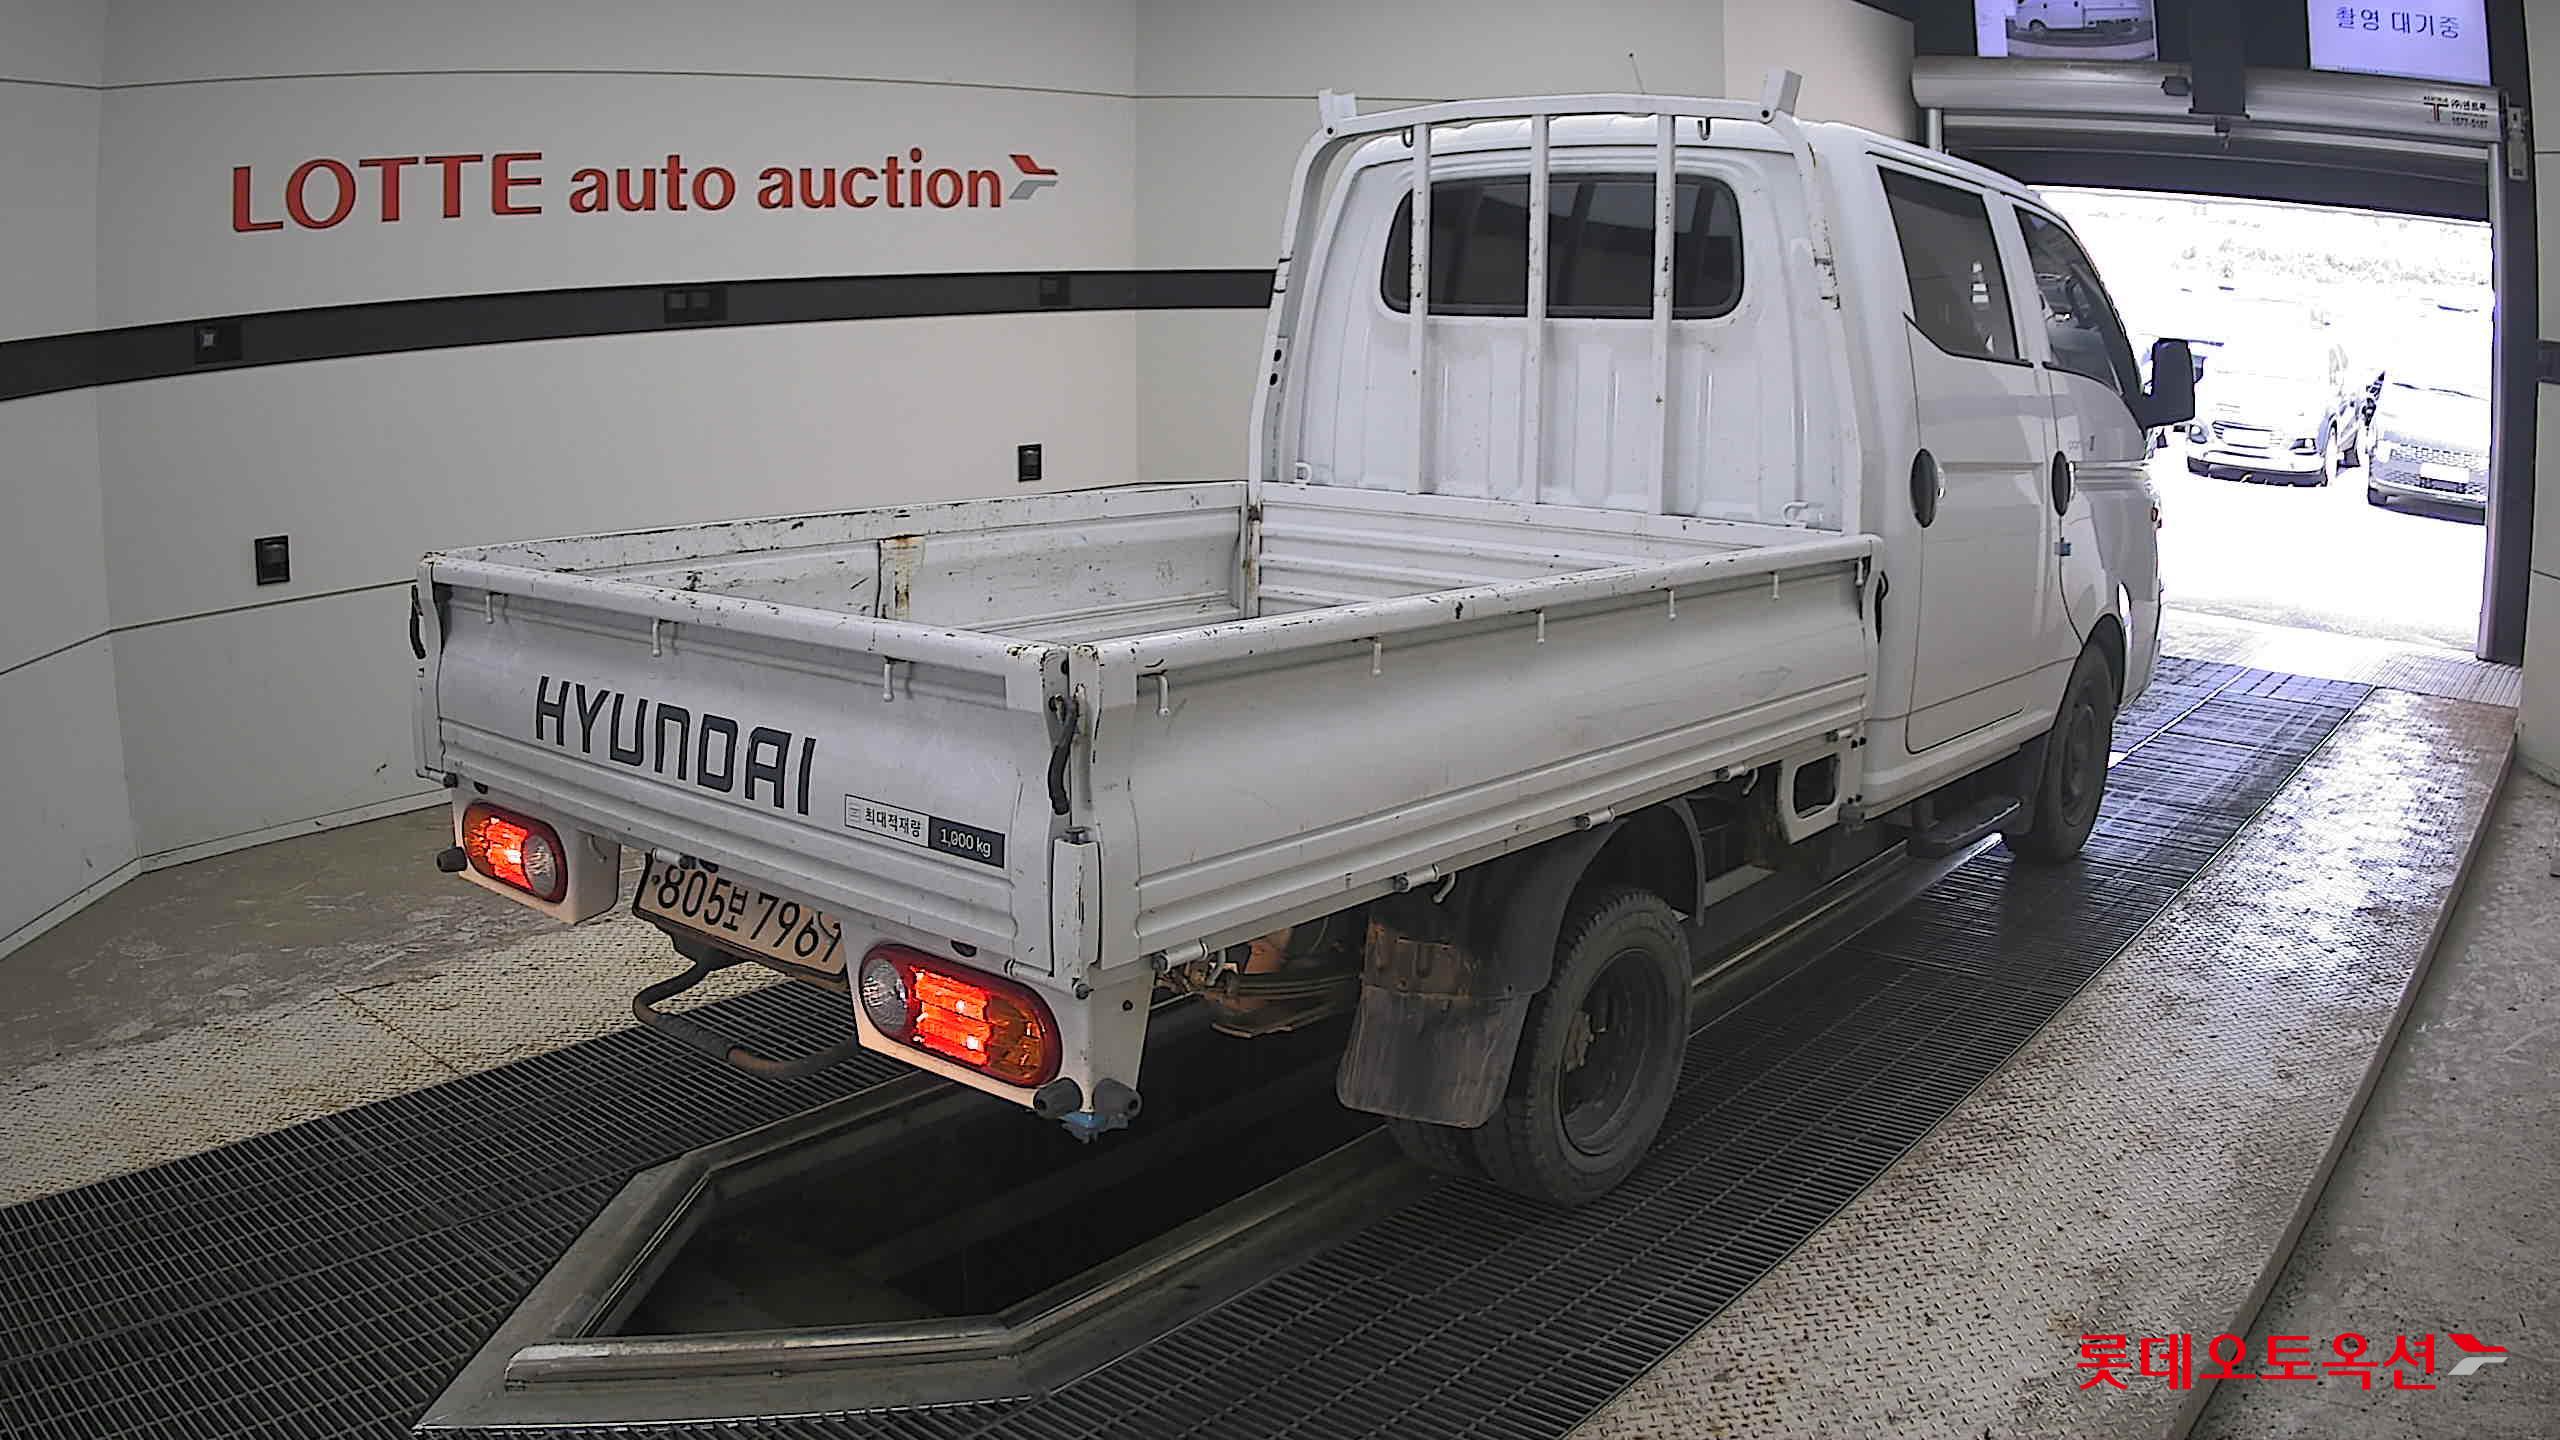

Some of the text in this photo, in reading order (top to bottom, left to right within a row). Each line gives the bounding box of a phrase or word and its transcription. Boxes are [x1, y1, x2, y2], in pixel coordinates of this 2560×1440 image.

[2336, 7, 2459, 39] 촬영 대기중
[232, 147, 1001, 233] LOTTE auto auction
[535, 675, 817, 816] HYUNDAI
[864, 807, 921, 838] 최대적재량
[940, 828, 974, 850] 1,000
[976, 837, 991, 858] kg
